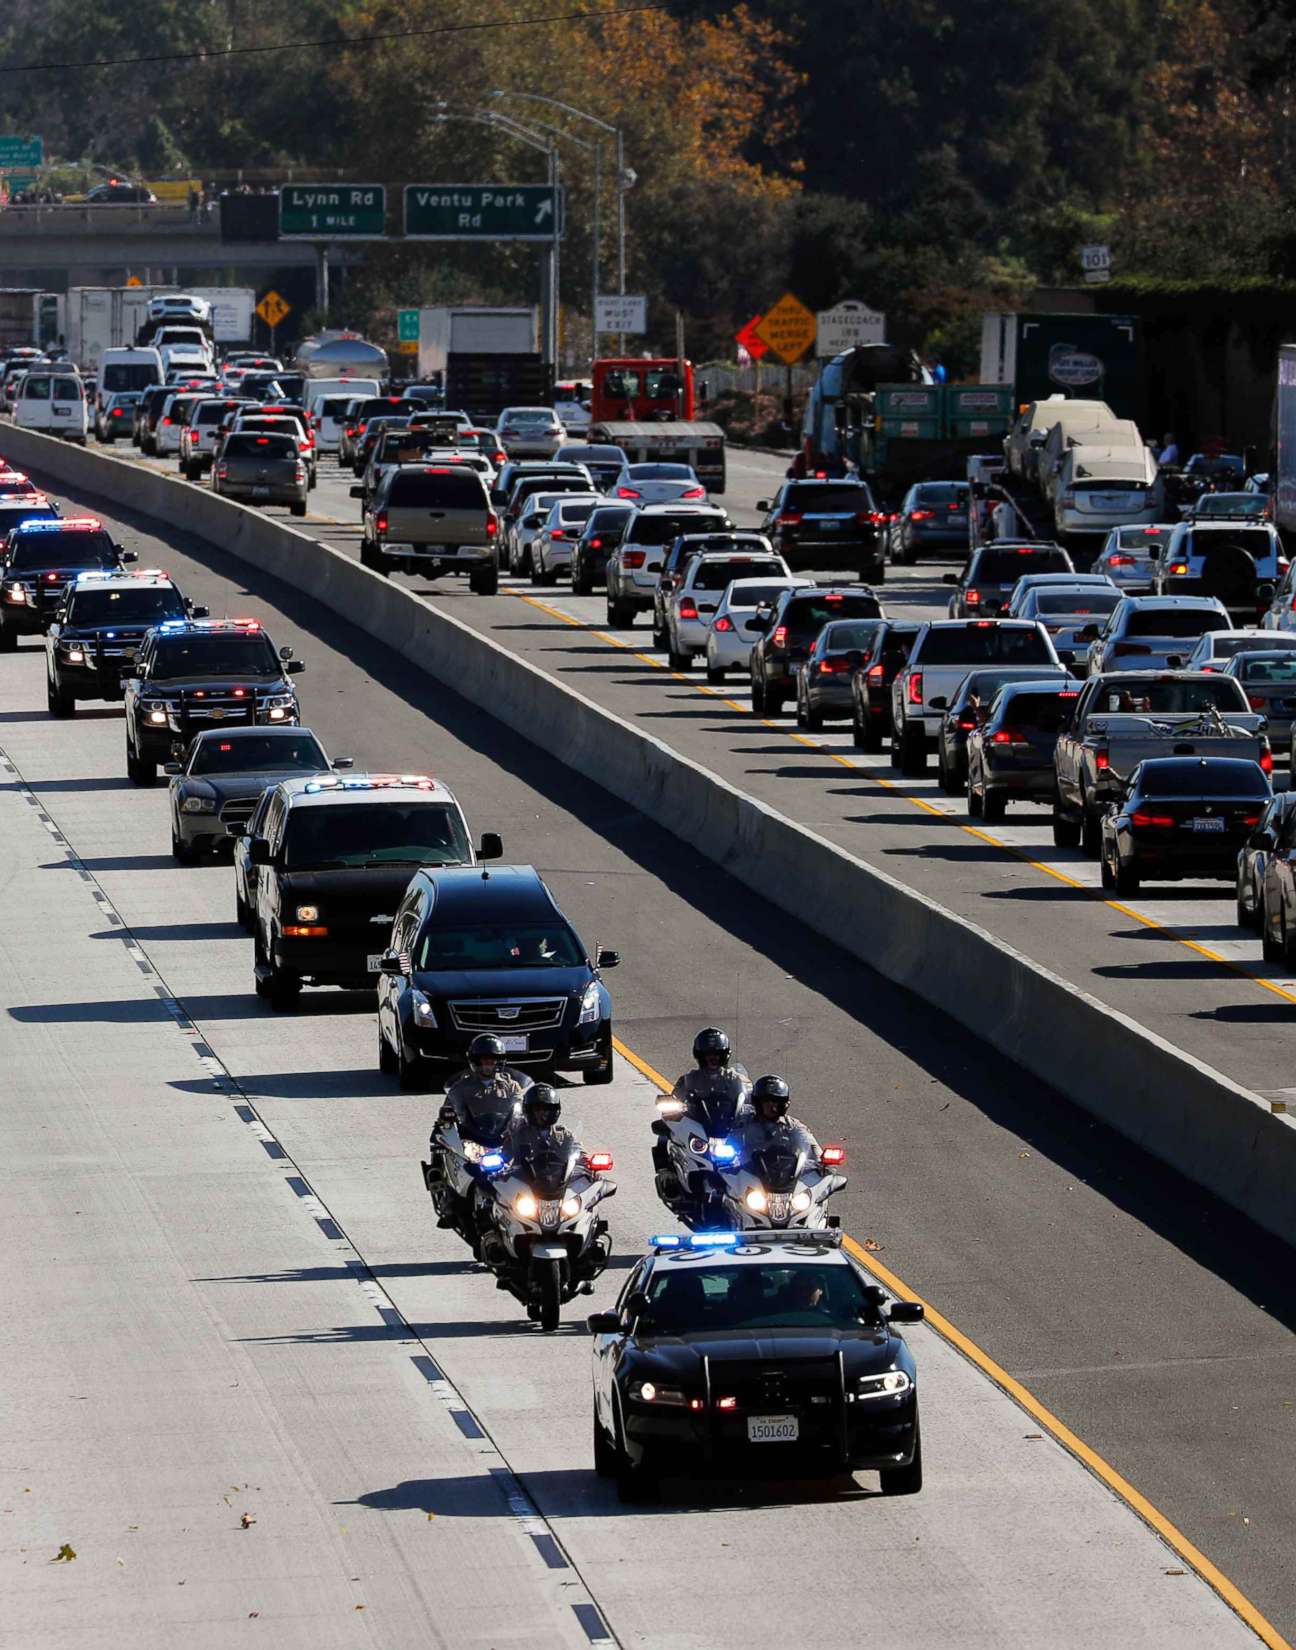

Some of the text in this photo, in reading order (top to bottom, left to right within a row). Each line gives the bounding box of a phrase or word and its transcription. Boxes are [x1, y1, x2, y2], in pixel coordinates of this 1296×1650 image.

[292, 191, 374, 207] Lynn Rd
[416, 191, 526, 207] Ventu Park
[311, 214, 356, 226] 1 MILE
[458, 213, 482, 227] Rd
[1086, 254, 1106, 266] 101
[605, 309, 634, 318] MUST
[607, 320, 633, 329] EXIT
[768, 318, 808, 326] TRAFFIC
[820, 315, 882, 326] STAGECOACH
[769, 330, 808, 339] MERGE
[778, 342, 803, 351] LEFT
[751, 1425, 796, 1438] 1501602
